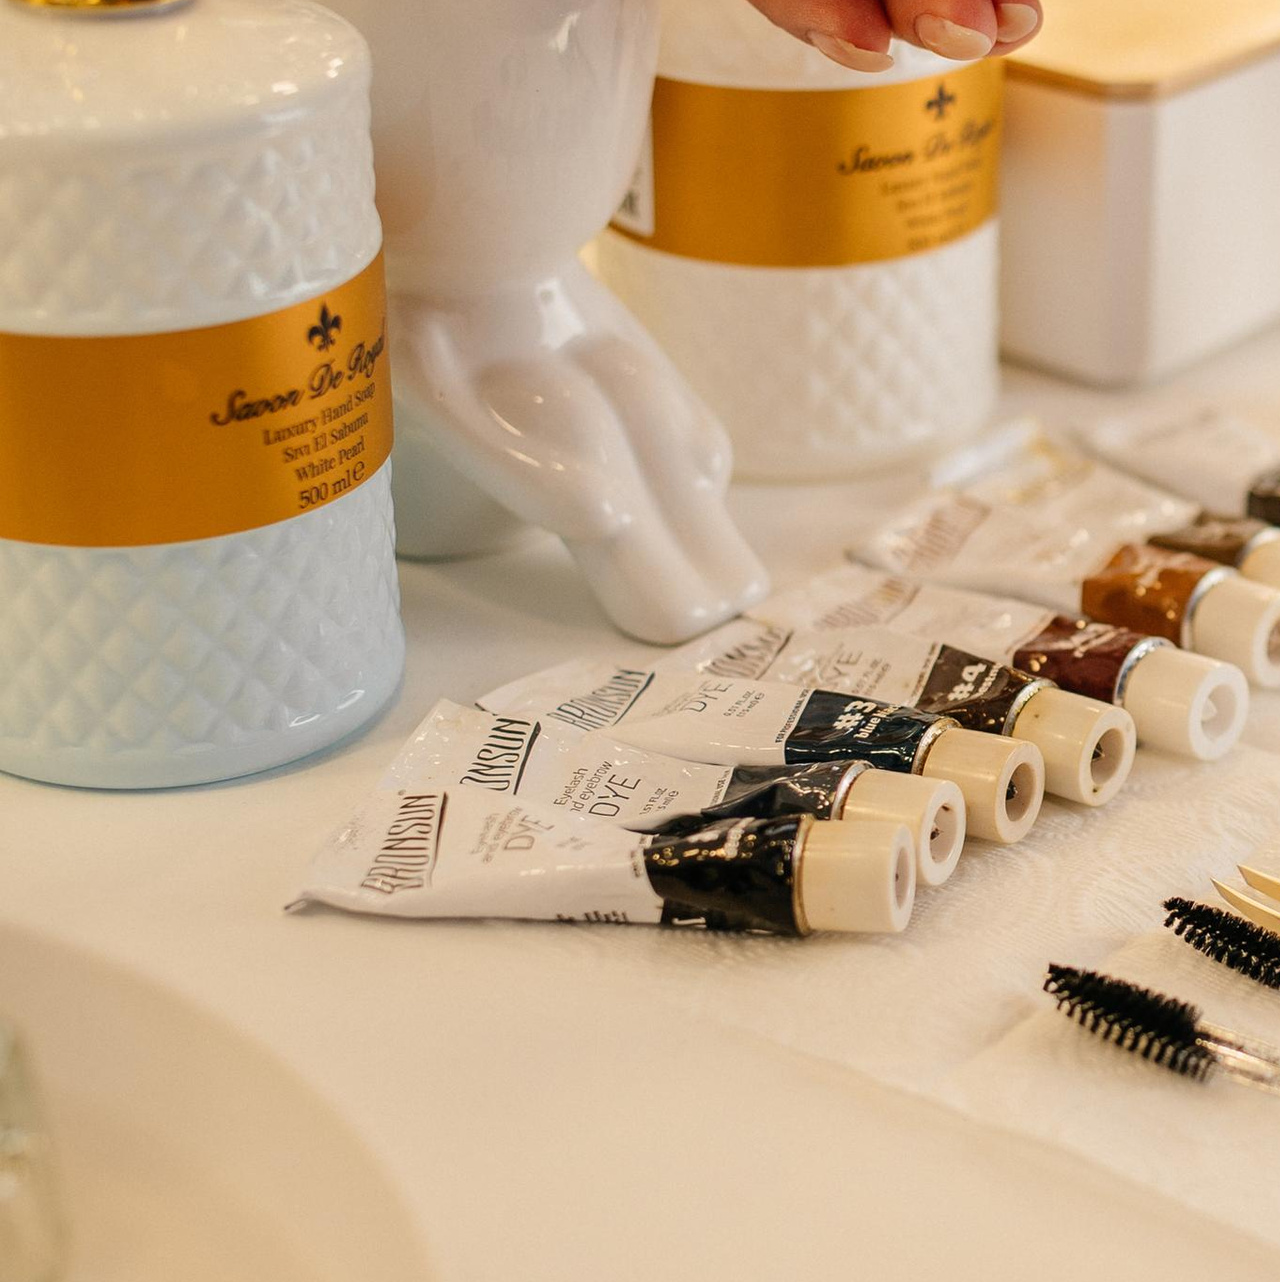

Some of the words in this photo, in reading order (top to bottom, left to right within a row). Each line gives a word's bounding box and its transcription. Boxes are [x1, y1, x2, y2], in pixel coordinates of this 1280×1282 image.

[211, 389, 304, 426] Savon
[308, 358, 344, 399] De
[262, 417, 318, 445] Luxury
[321, 394, 354, 423] Hand
[355, 382, 377, 408] Soap
[294, 457, 336, 482] White
[339, 436, 365, 466] Pearl
[314, 435, 328, 452] El
[299, 482, 329, 509] 500
[680, 680, 734, 713] DYE
[947, 663, 987, 701] #4
[833, 701, 877, 729] #3
[853, 717, 881, 739] blue
[460, 717, 530, 791] ONSUN
[554, 767, 588, 806] Eyelash
[580, 760, 612, 802] eyebrow
[588, 774, 641, 817] DYE
[503, 815, 555, 851] DYE
